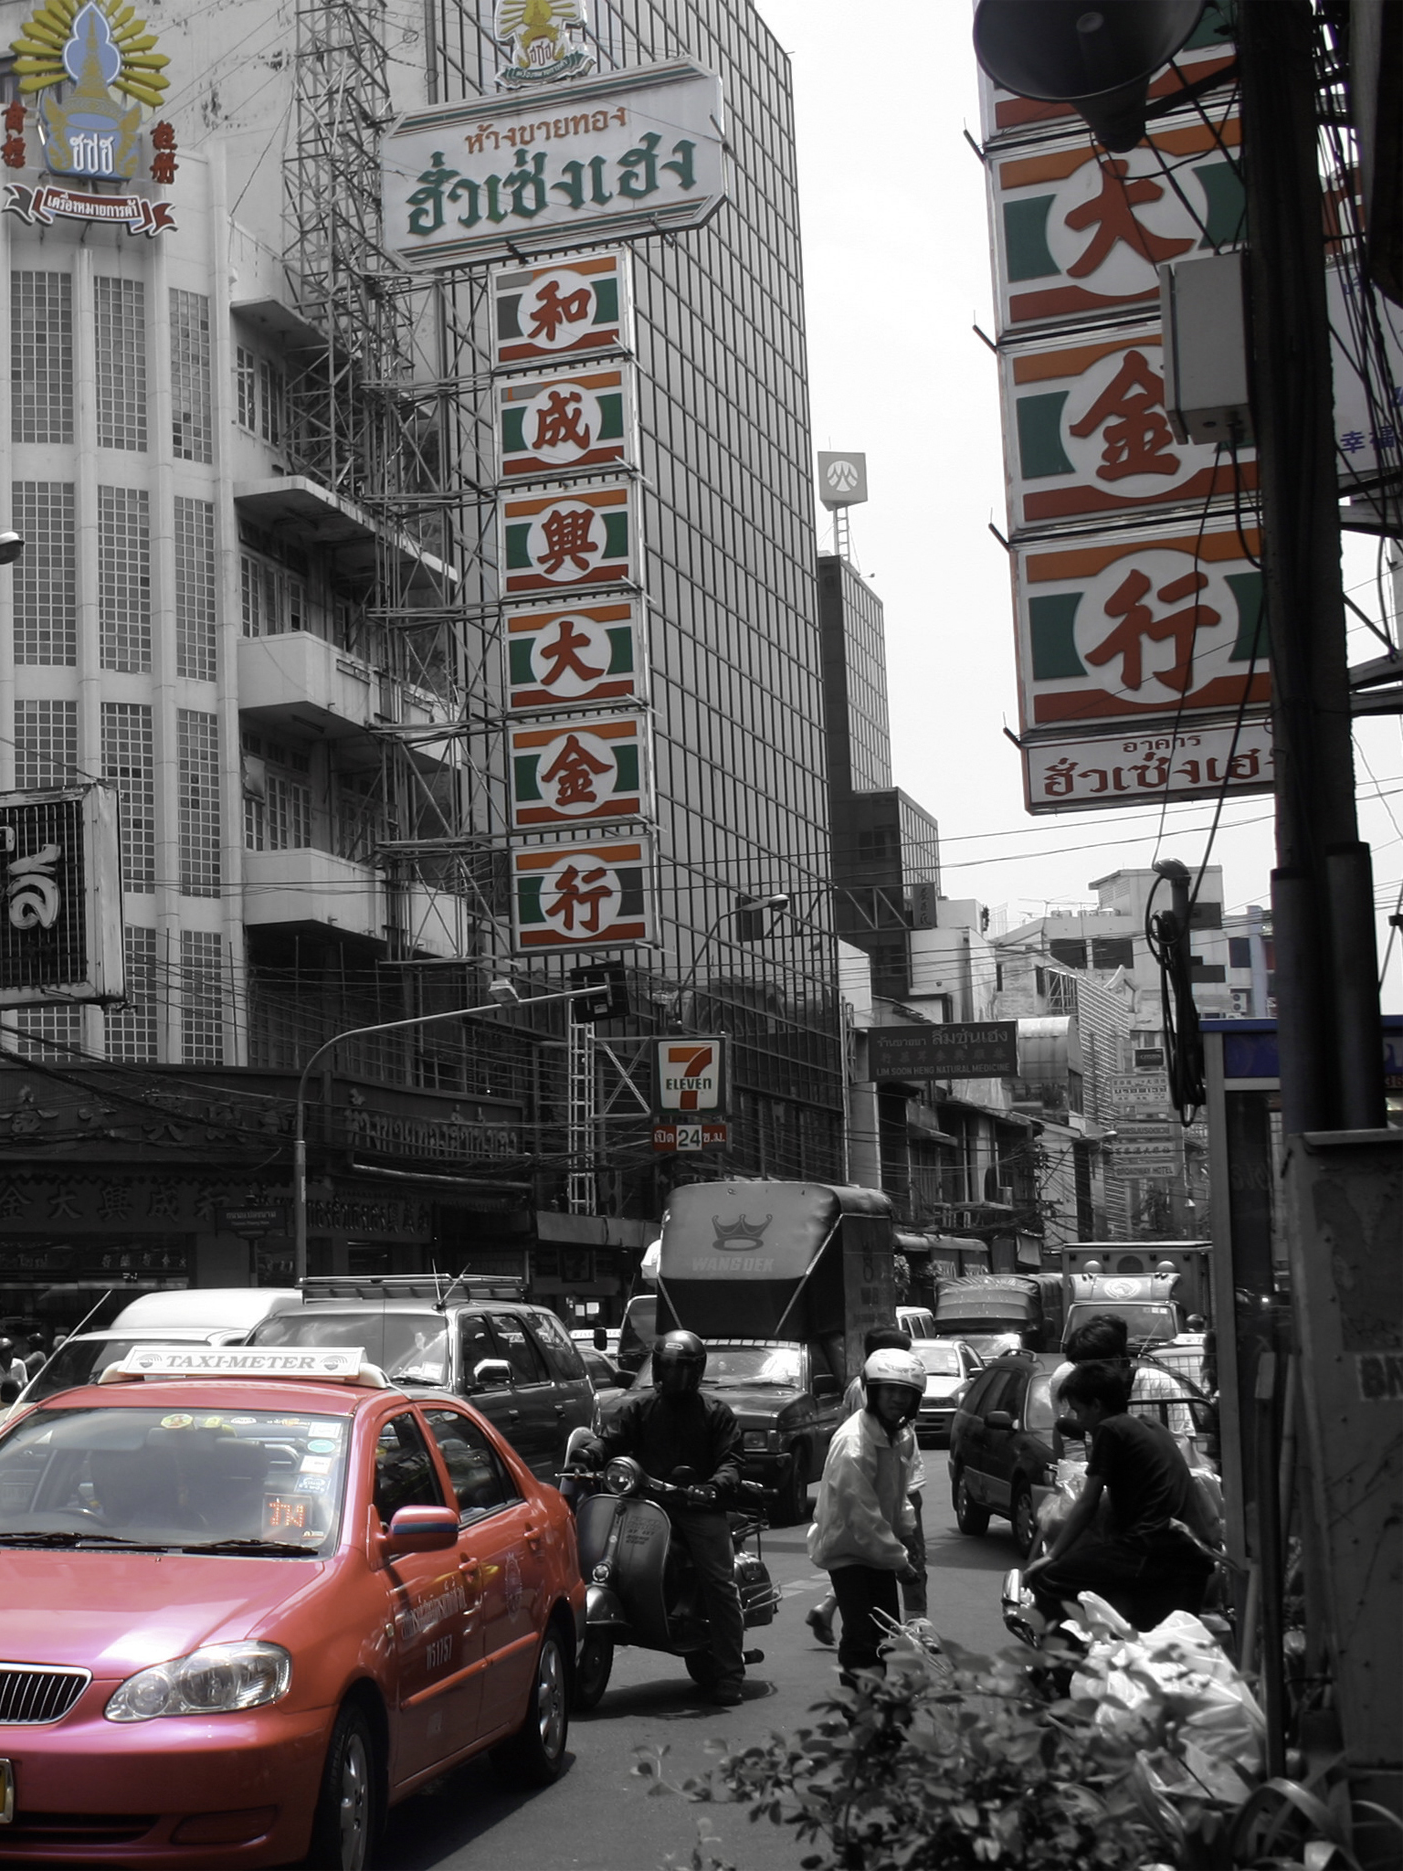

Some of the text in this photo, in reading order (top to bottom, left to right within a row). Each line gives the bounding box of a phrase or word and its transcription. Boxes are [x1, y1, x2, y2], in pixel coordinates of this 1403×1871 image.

[465, 106, 627, 155] ห้างขายทอง
[405, 131, 697, 237] ฮั่วเซ่งเฮง
[46, 191, 138, 218] เครื่องหมายการค้า
[1122, 735, 1202, 753] อาคาร
[1044, 747, 1275, 797] ฮั่วเซ่งเฮ
[668, 1046, 713, 1110] 7
[876, 1062, 1010, 1077] LIM SOON HENG NATURAL MEDICINE
[654, 1129, 675, 1143] เปิด
[678, 1129, 701, 1147] 24
[1152, 1165, 1173, 1175] HOTEL
[166, 1355, 316, 1370] TAXI-METER
